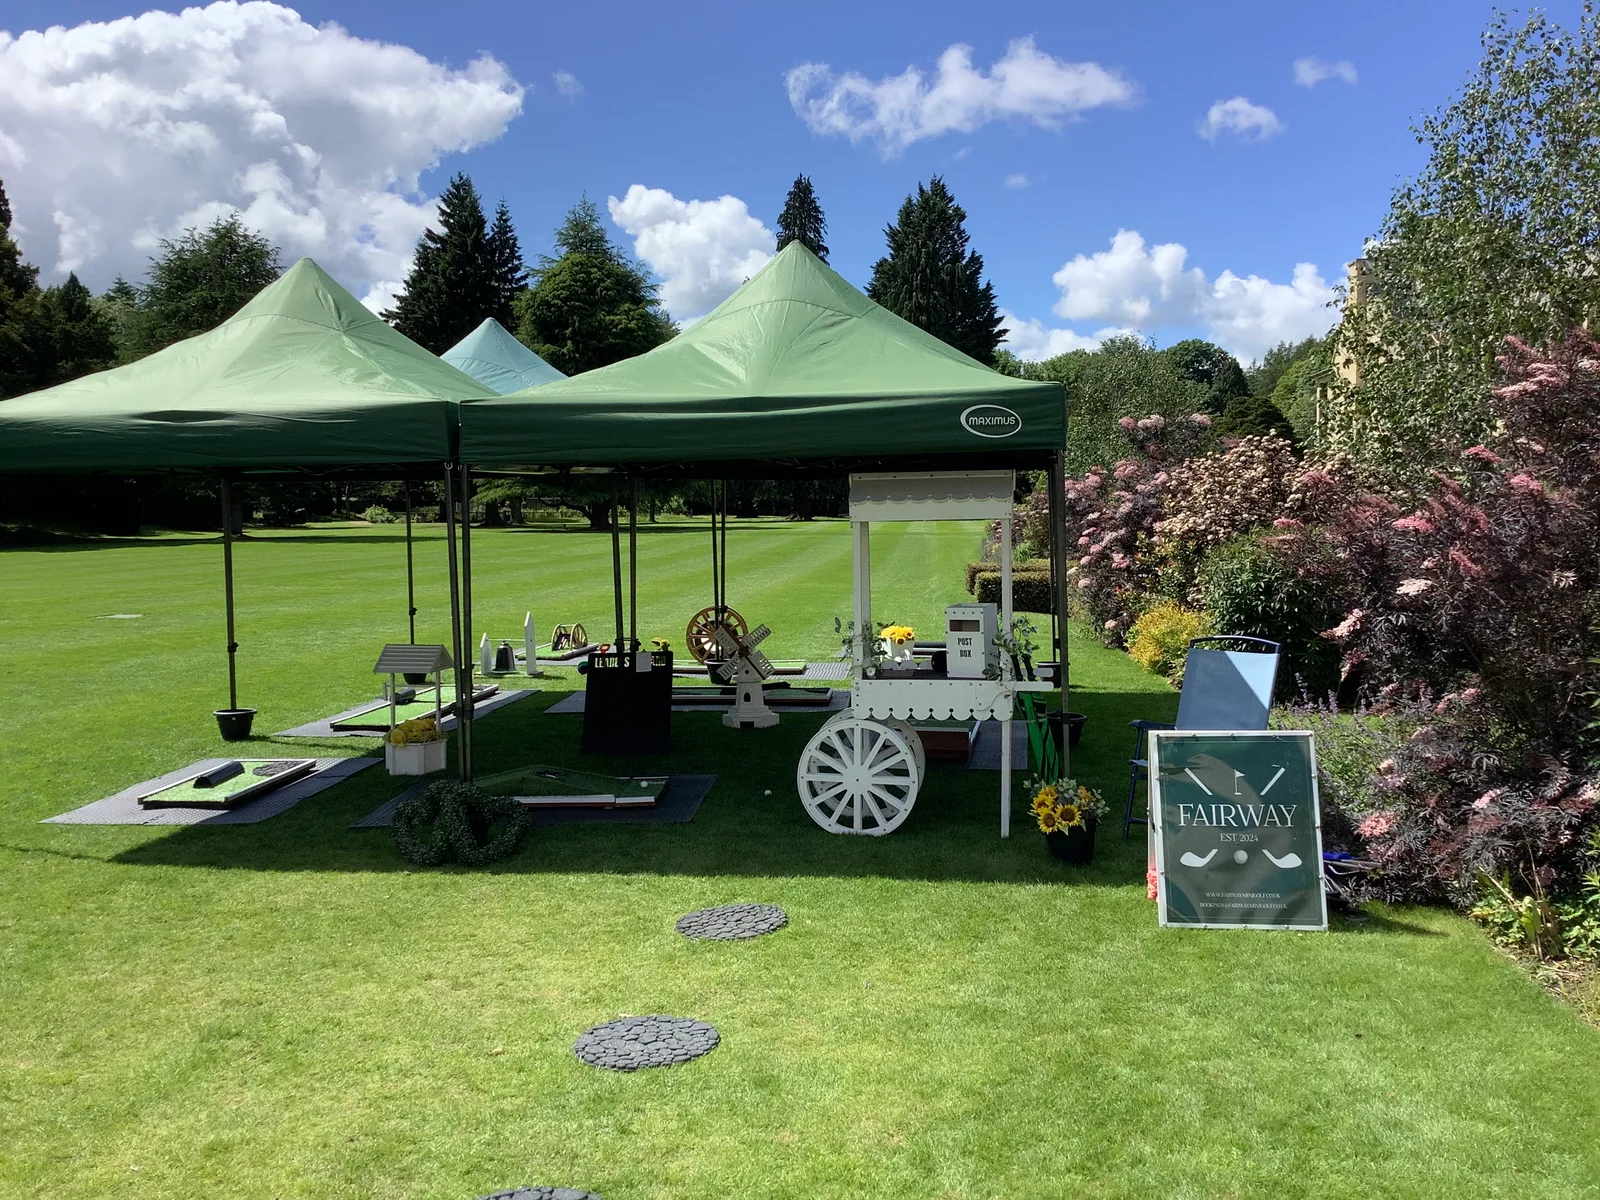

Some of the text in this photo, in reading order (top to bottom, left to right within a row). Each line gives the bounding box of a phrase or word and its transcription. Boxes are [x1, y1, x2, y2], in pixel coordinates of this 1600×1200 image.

[968, 416, 1016, 426] MAXIMUS
[957, 637, 972, 646] POST
[959, 649, 972, 658] BOX
[594, 656, 630, 668] LEADES
[1177, 803, 1298, 828] FAIRWAY
[1220, 833, 1259, 842] EST 2024
